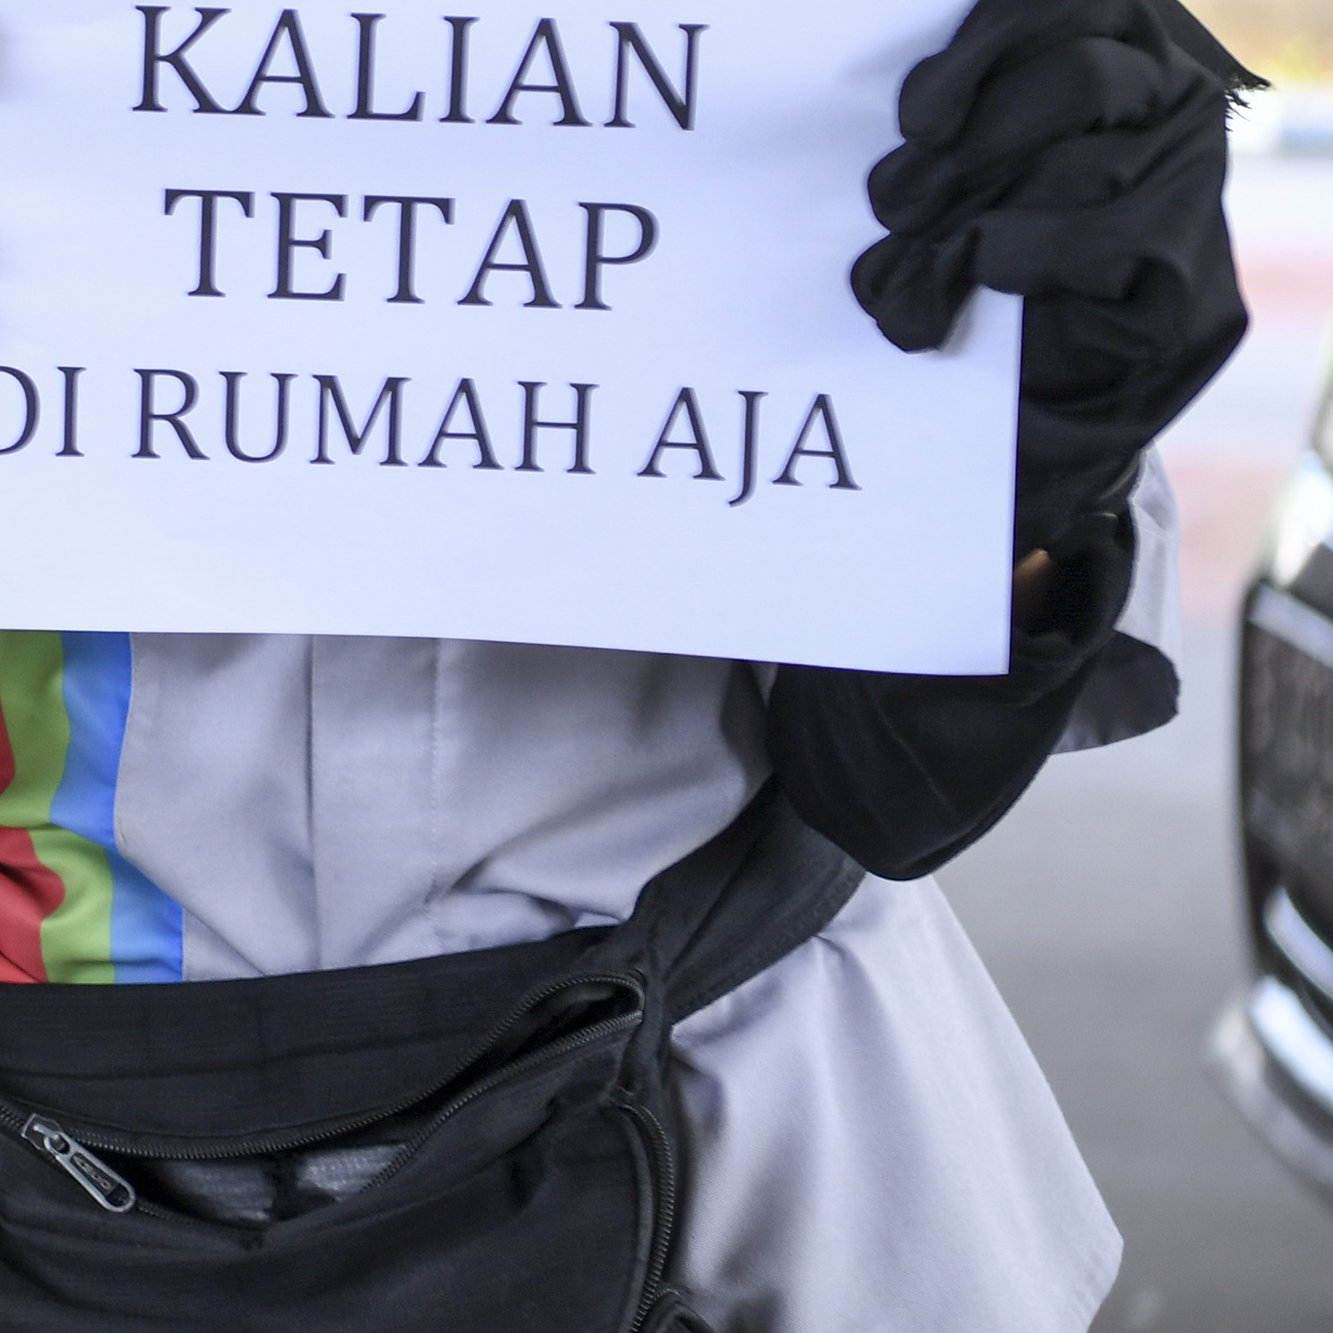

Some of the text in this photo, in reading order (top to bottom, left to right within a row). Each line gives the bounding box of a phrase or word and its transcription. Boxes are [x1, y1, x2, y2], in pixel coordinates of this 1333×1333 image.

[132, 5, 710, 132] KALIAN
[164, 188, 659, 311] TETAP
[131, 368, 598, 475] RUMAH
[636, 386, 860, 507] AJA
